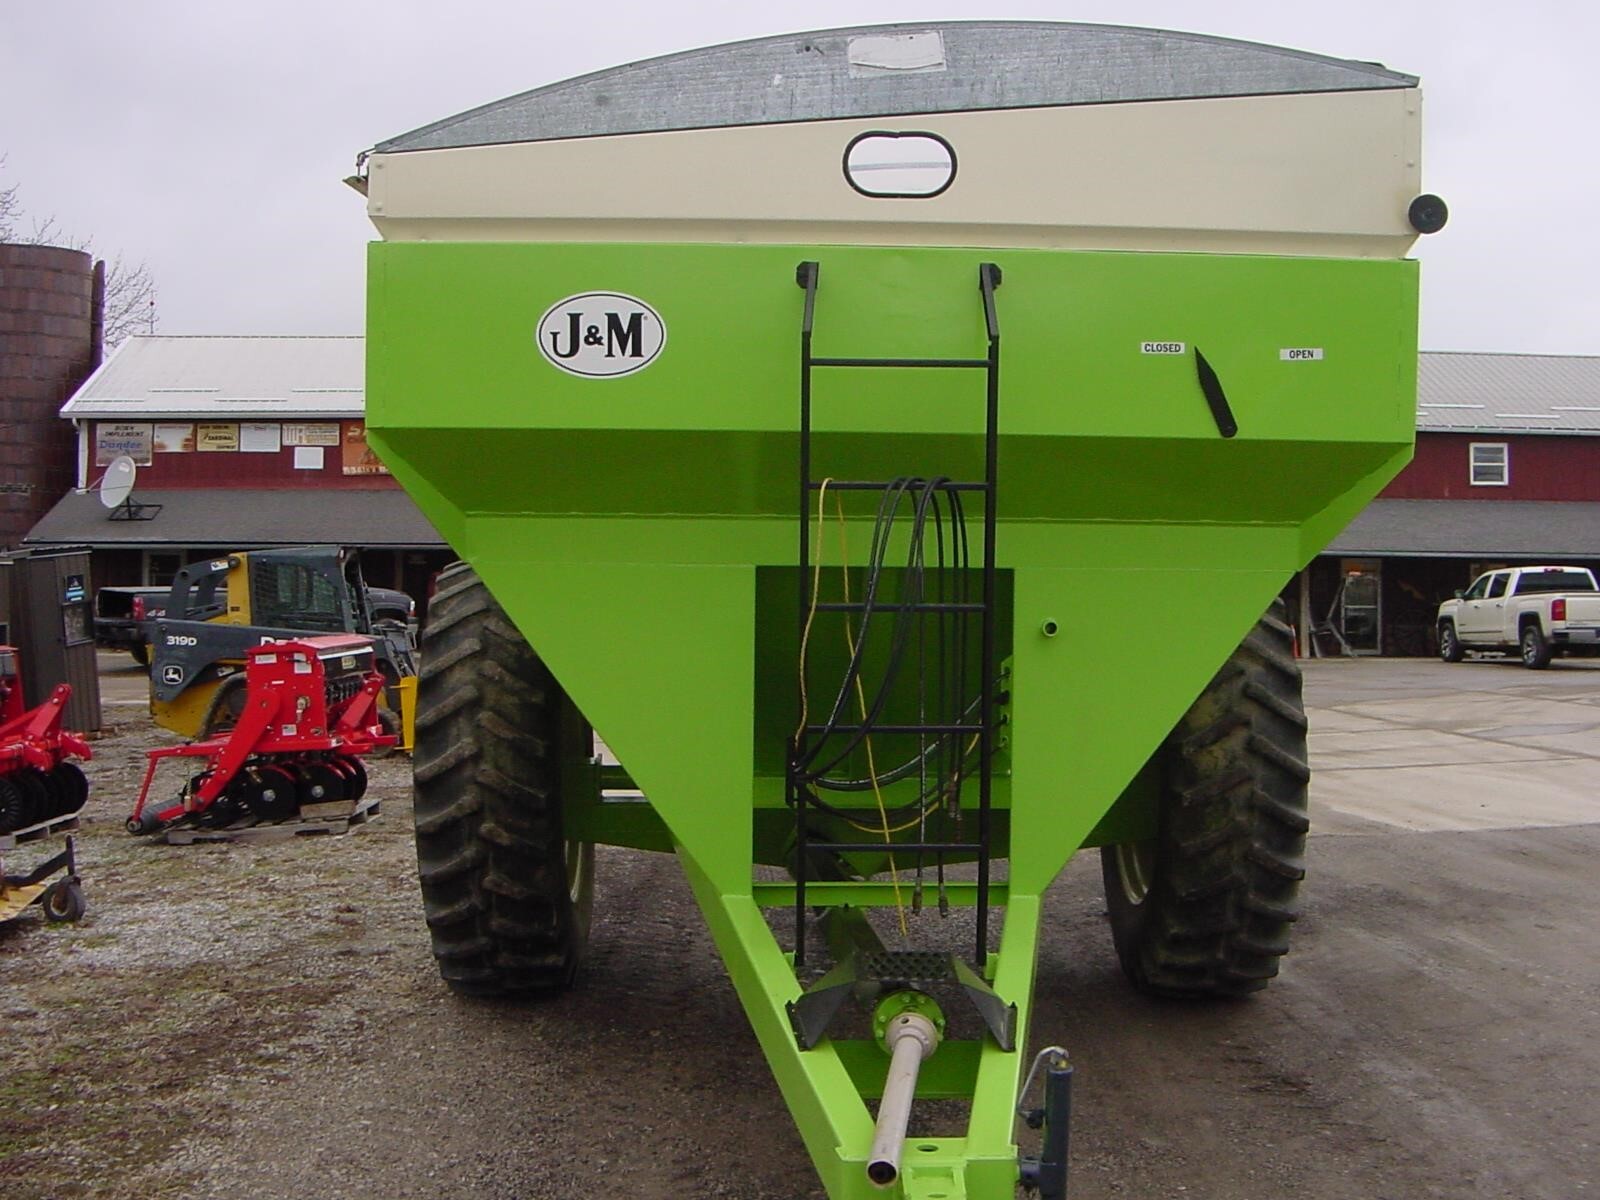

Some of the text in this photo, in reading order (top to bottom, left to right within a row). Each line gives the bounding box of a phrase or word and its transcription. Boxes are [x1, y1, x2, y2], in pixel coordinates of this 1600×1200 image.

[550, 312, 645, 358] J&M
[1144, 343, 1181, 353] CLOSED
[1289, 349, 1314, 359] OPEN
[166, 635, 198, 646] 319D
